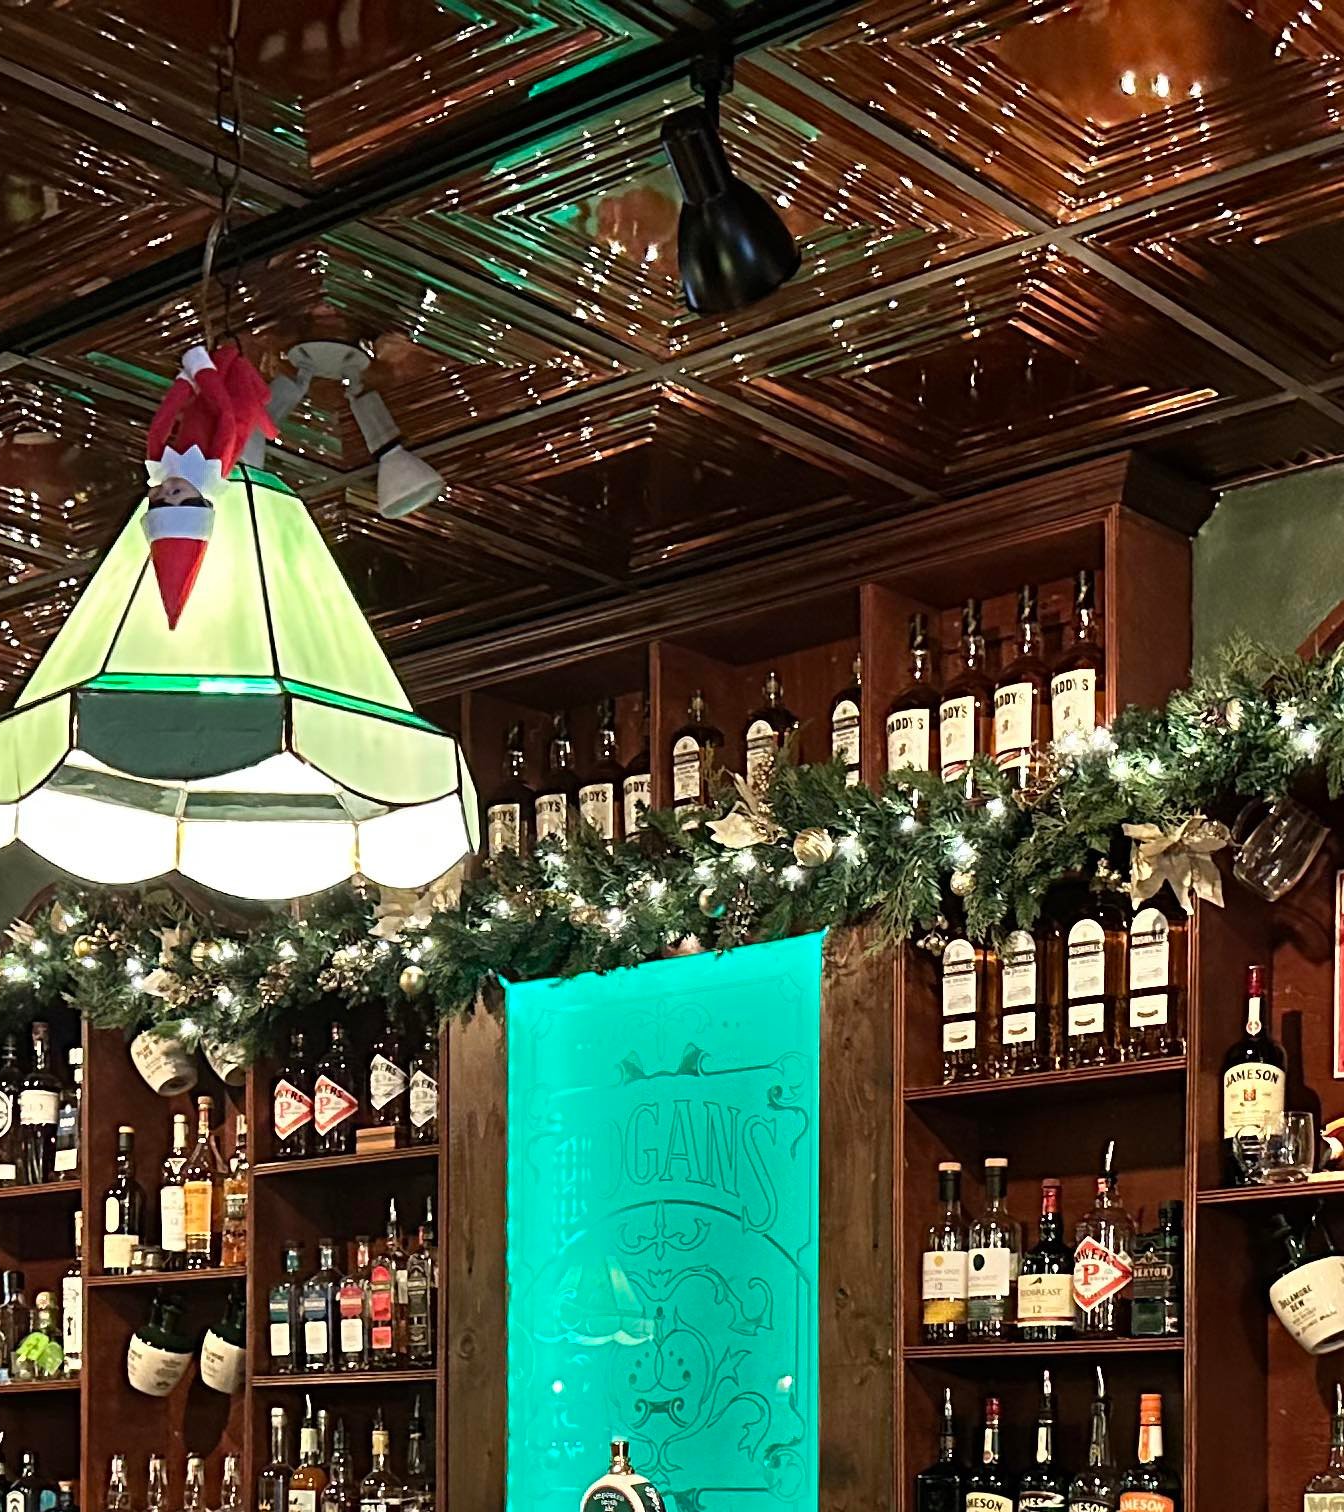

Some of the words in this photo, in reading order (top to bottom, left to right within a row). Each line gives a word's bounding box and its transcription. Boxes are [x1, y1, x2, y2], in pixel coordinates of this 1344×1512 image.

[1051, 678, 1089, 697] PADDYS
[887, 716, 924, 735] PADDYS
[1225, 1068, 1279, 1088] JAMESON
[1081, 1264, 1100, 1285] P
